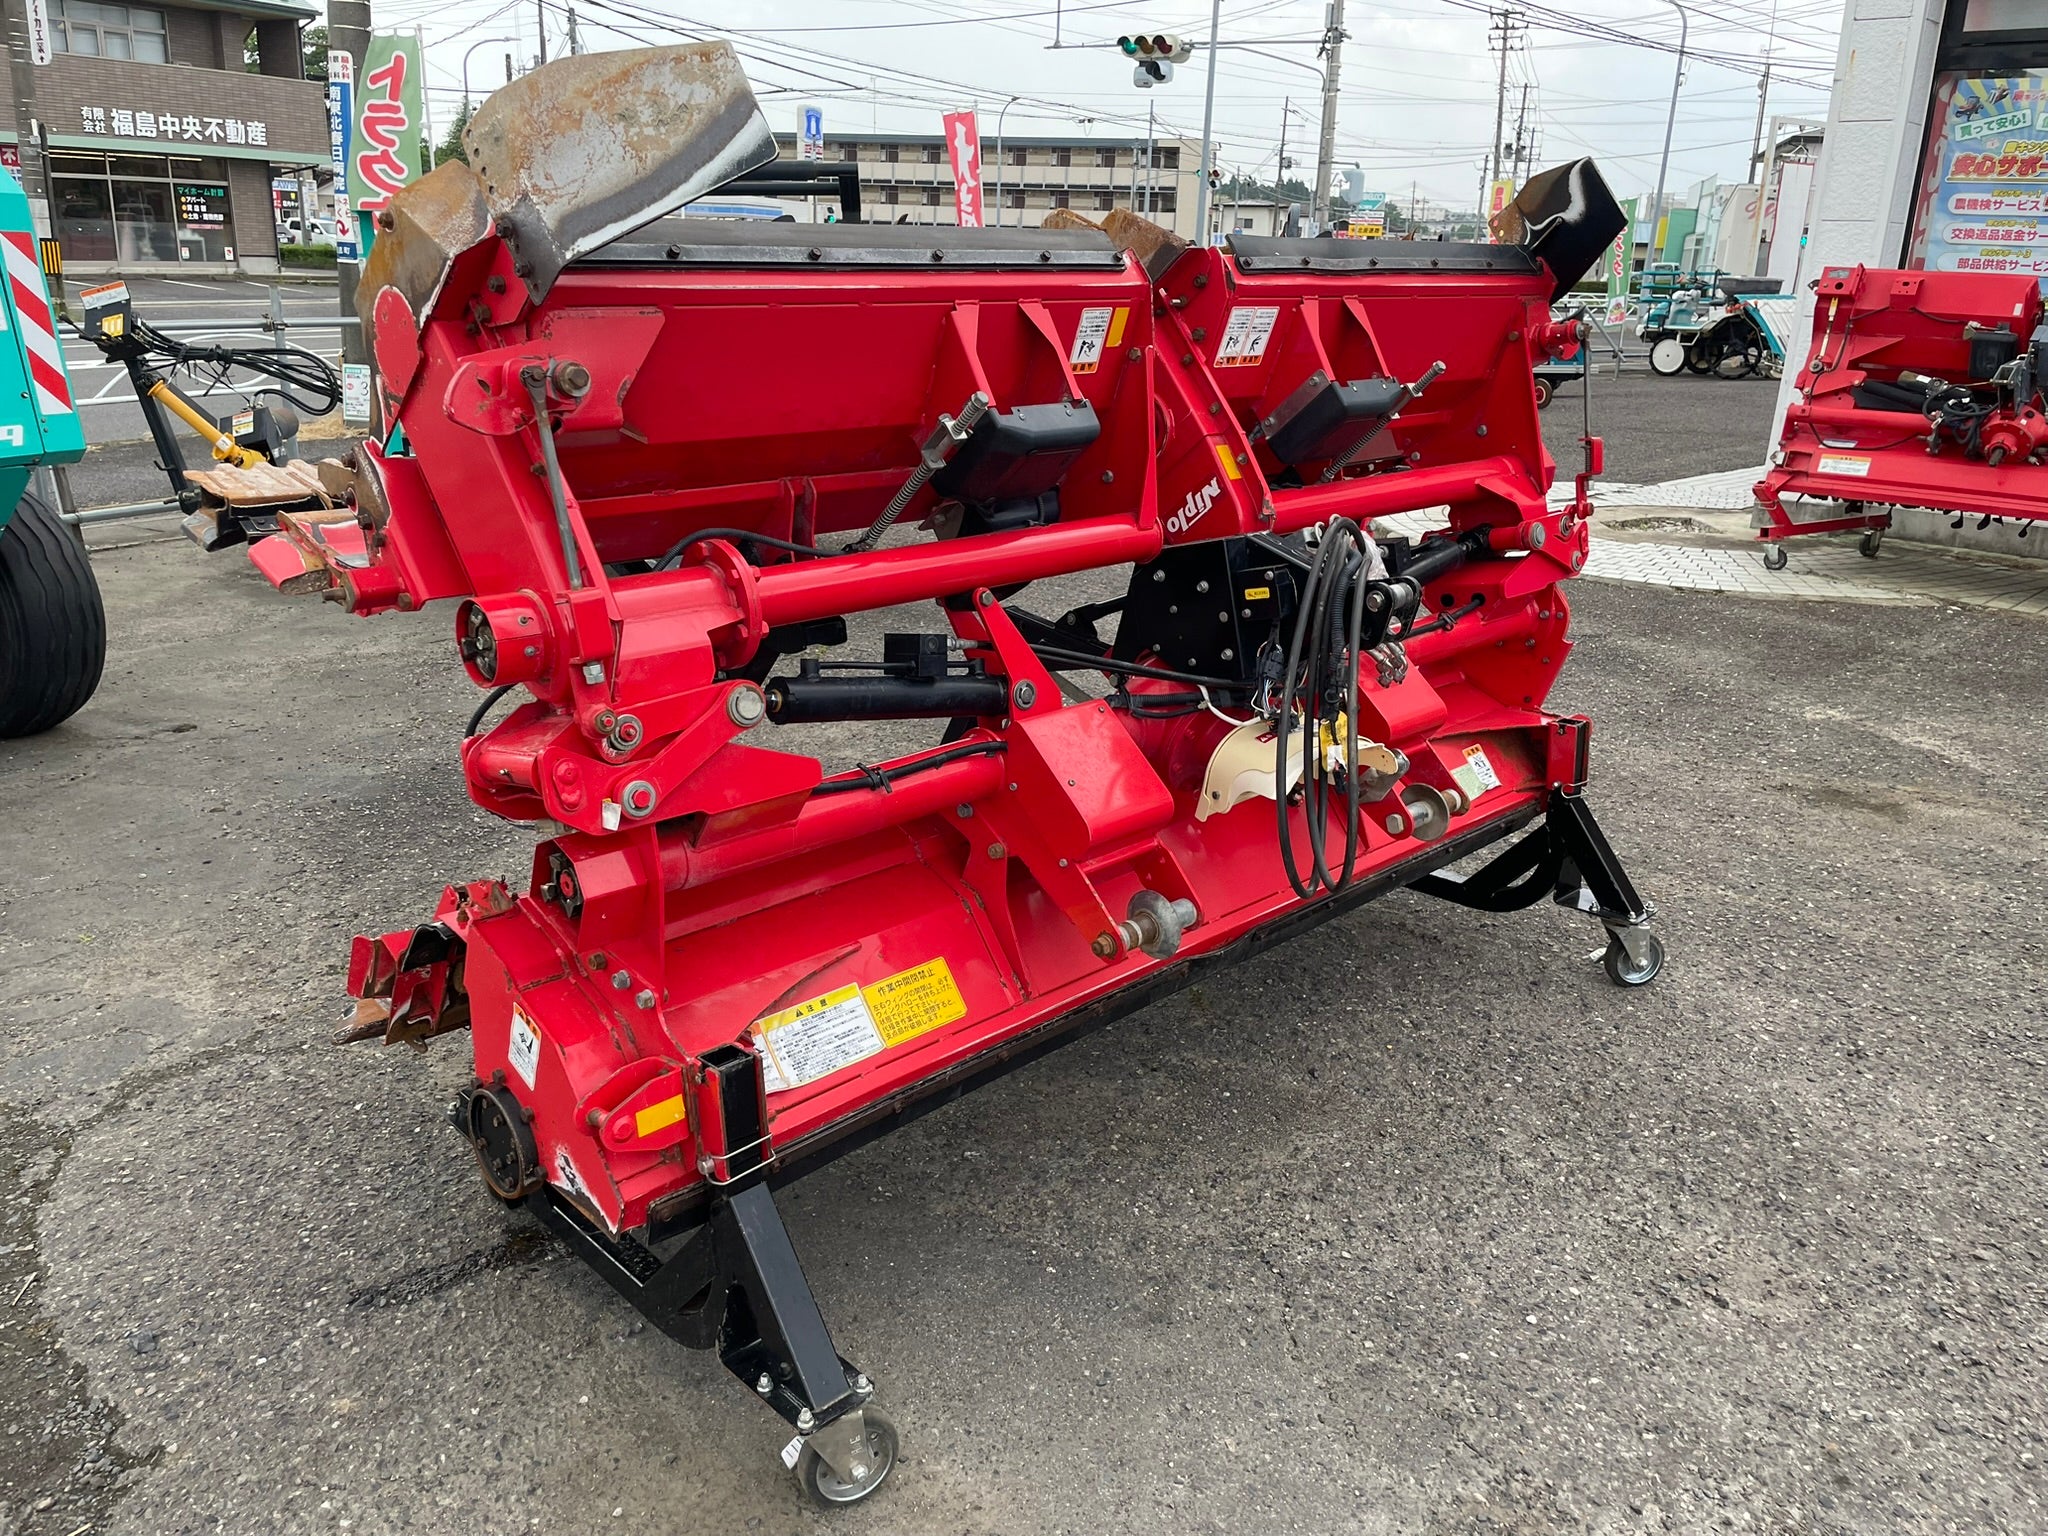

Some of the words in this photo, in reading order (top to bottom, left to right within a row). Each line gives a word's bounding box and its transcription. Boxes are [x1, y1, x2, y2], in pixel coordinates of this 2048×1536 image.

[33, 0, 45, 53] イカ工業
[80, 106, 105, 121] 有限
[82, 119, 107, 135] 会社
[110, 108, 268, 146] 福島中央不動産
[1167, 476, 1221, 533] Niplo
